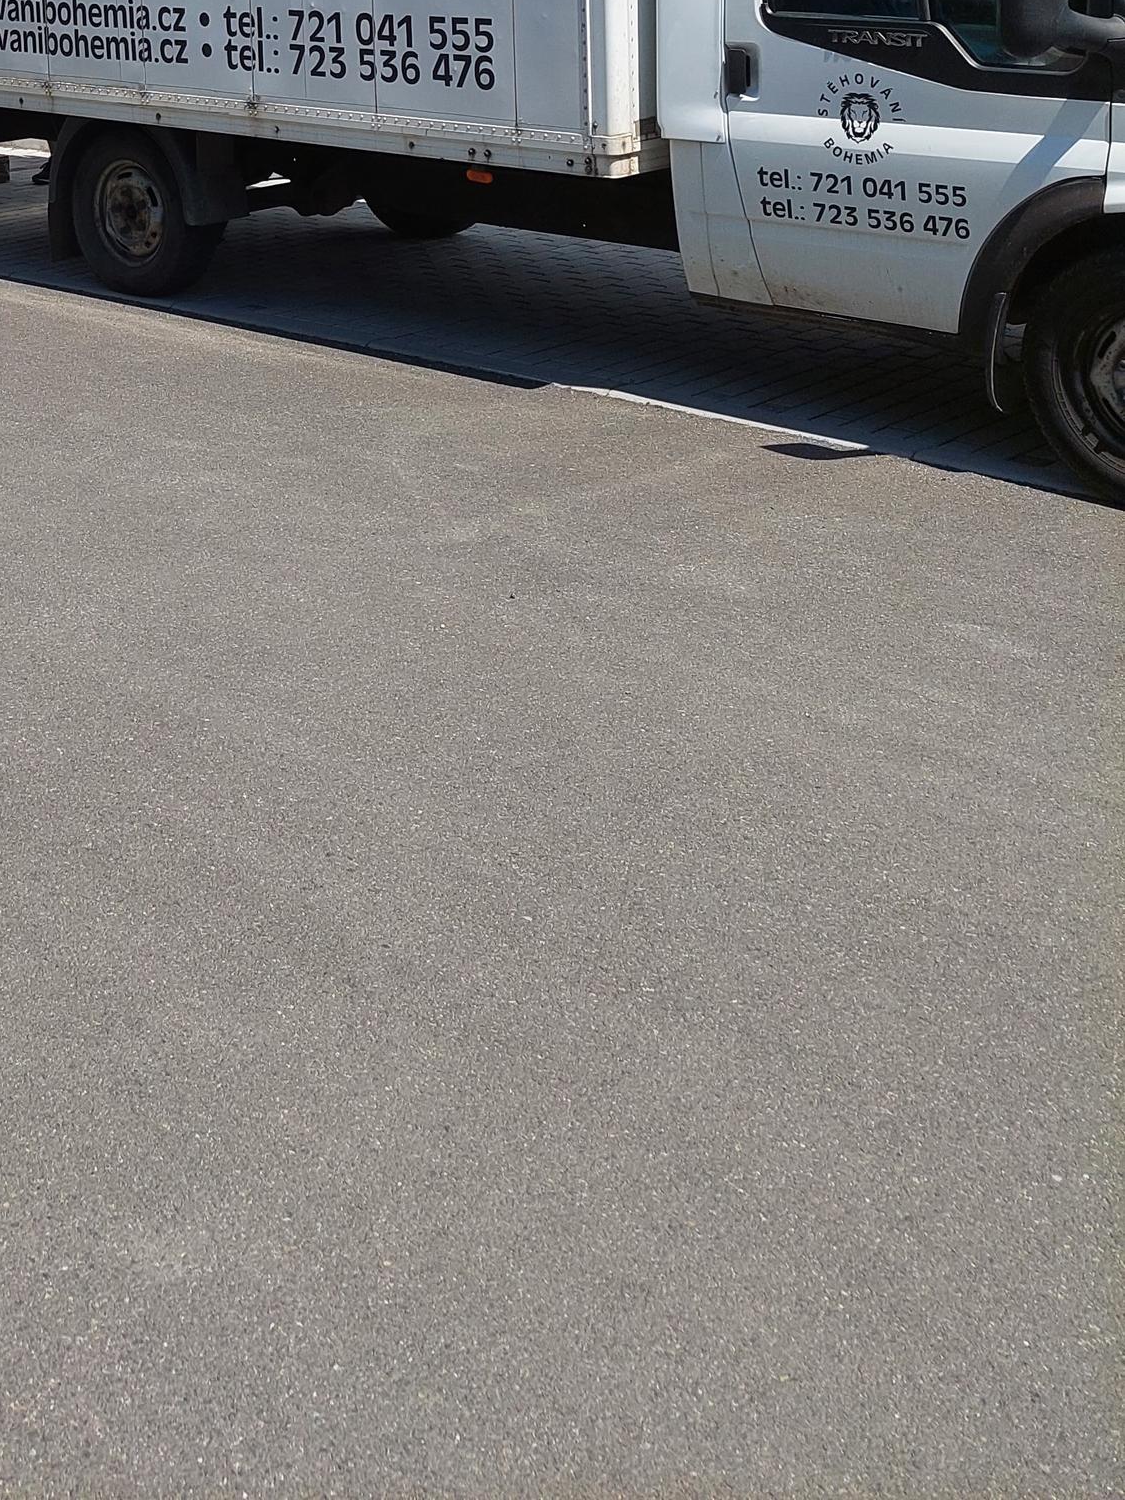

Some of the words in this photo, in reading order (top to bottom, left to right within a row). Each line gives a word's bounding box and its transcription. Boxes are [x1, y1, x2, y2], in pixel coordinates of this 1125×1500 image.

[288, 9, 343, 44] 721
[355, 12, 413, 48] 041
[428, 15, 494, 53] 555
[828, 29, 928, 48] TRANSIT
[288, 43, 347, 79] 723
[359, 48, 421, 85] 536
[431, 53, 496, 91] 476
[817, 72, 907, 123] STĚHOVÁNÍ
[823, 137, 895, 165] BOHEMIA
[756, 166, 803, 191] tel.:
[809, 171, 853, 196] 721
[862, 177, 907, 201] 041
[917, 183, 968, 207] 555
[759, 196, 806, 221] tel.:
[812, 202, 859, 227] 723
[867, 208, 915, 233] 536
[923, 215, 971, 240] 476
